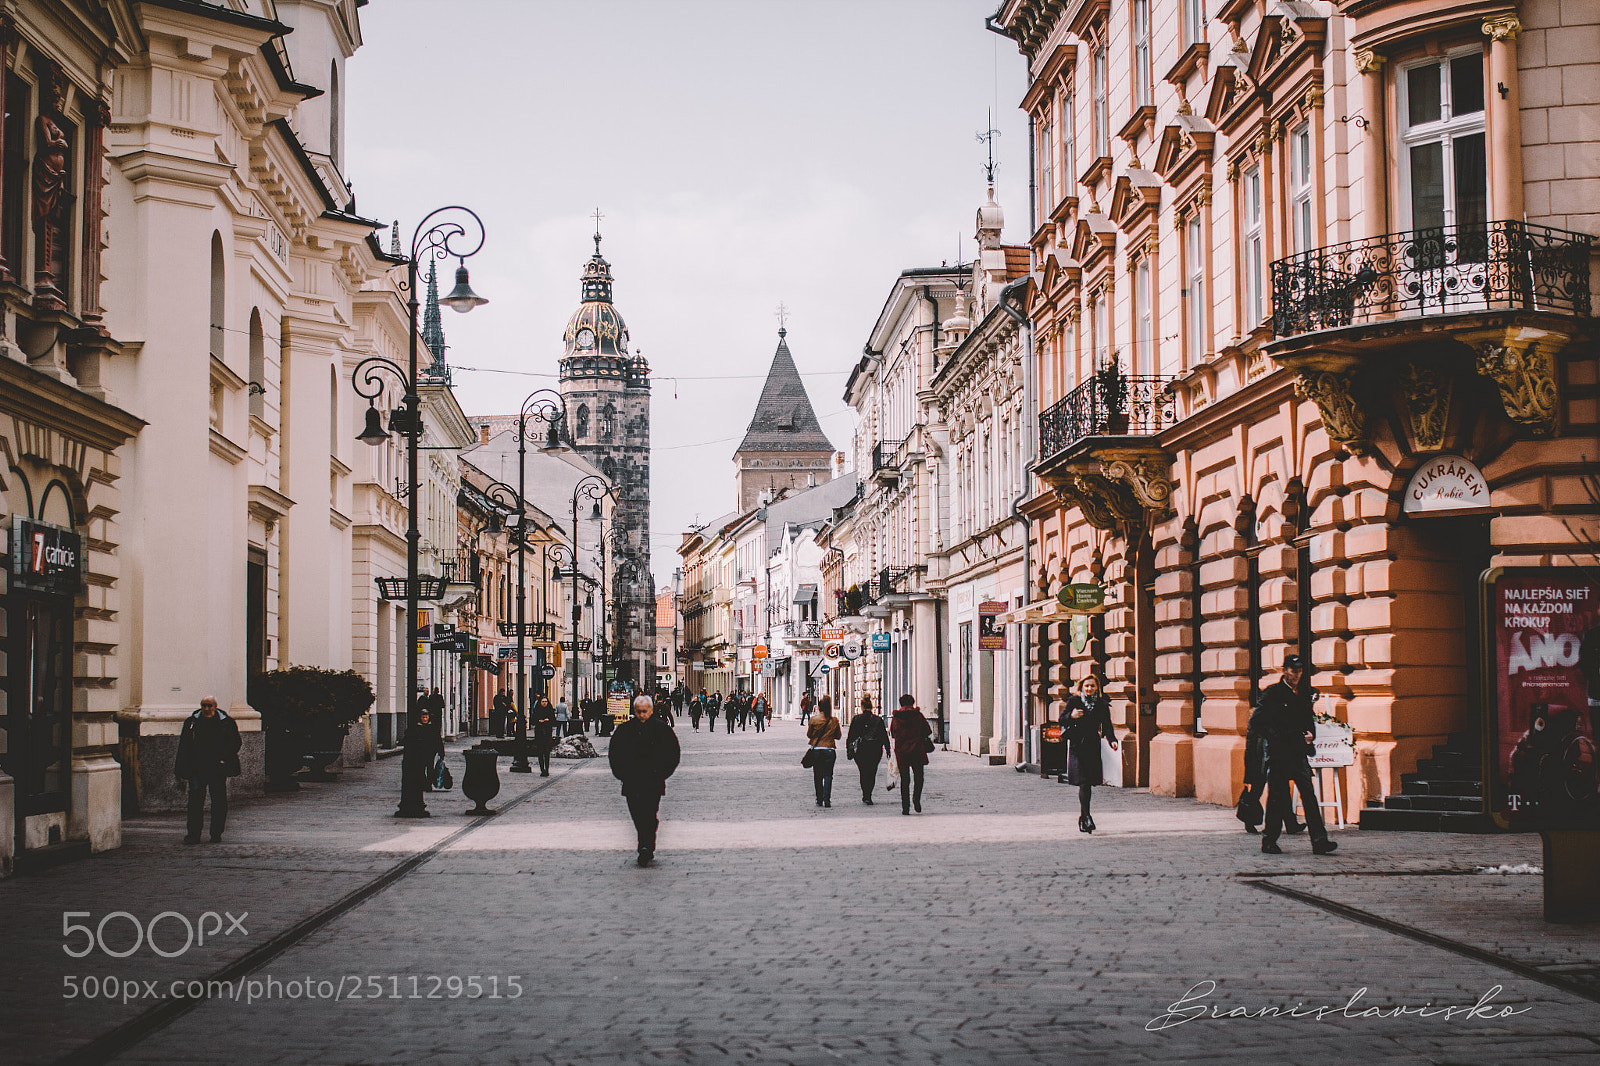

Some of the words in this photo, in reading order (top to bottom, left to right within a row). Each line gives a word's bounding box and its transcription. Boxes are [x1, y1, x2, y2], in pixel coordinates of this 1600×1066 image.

[1413, 460, 1483, 501] CUKRÁREŇ
[34, 533, 44, 572] 7
[45, 545, 75, 568] camicie
[1504, 586, 1563, 600] NAJLEPŠIA
[1565, 586, 1590, 600] SIEŤ
[1504, 603, 1521, 614] NA
[1523, 601, 1573, 614] KAŽDOM
[1504, 616, 1551, 628] KROKU?
